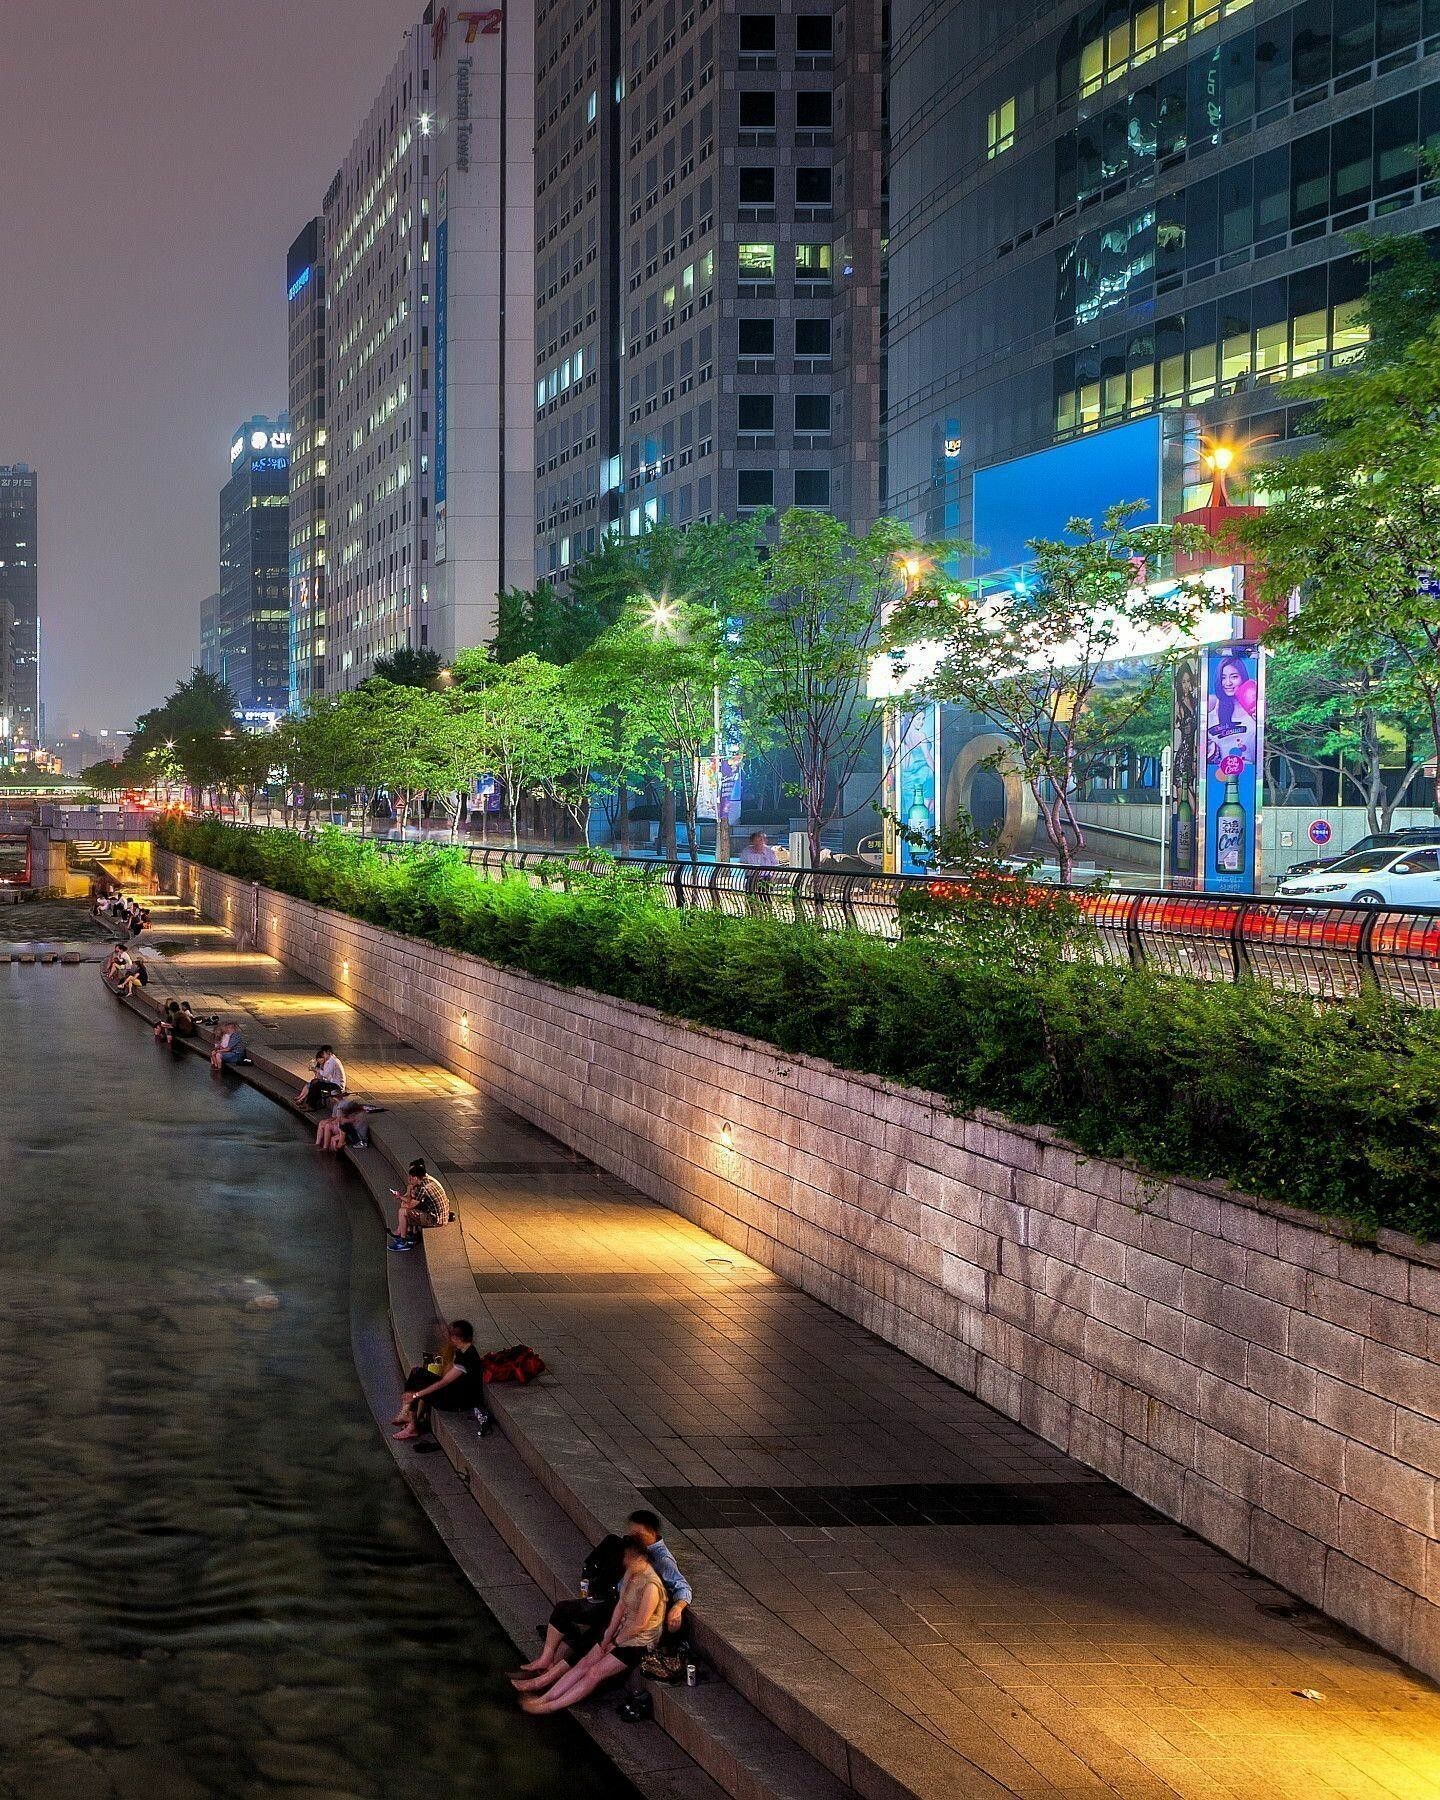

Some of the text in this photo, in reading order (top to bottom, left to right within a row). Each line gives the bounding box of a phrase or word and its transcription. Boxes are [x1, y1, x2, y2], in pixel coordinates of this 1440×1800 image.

[457, 8, 503, 43] T2
[457, 56, 473, 173] Tourism Tower
[269, 432, 292, 449] 신
[867, 840, 883, 849] 청계
[1218, 828, 1244, 852] Cool
